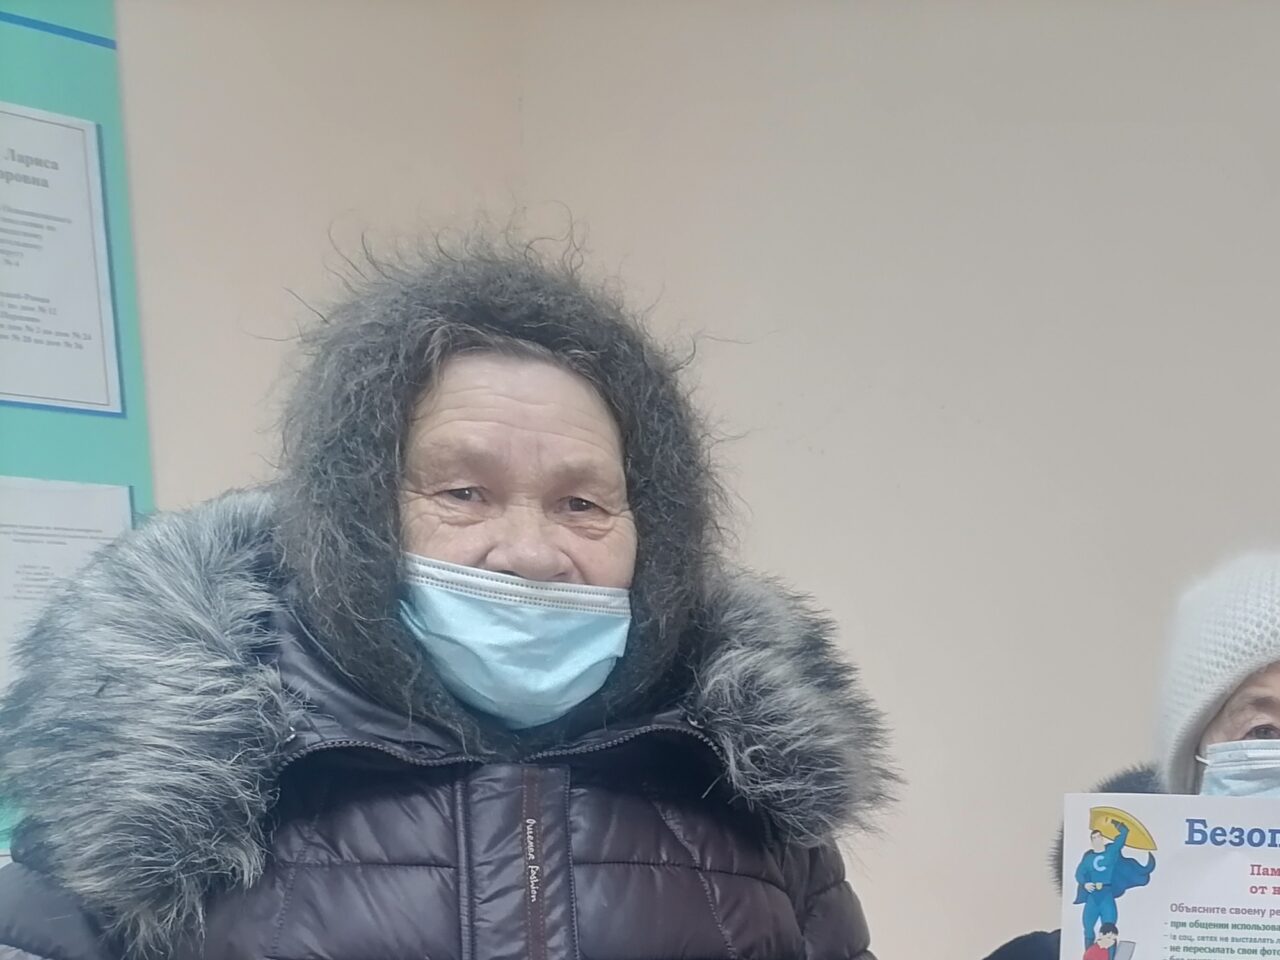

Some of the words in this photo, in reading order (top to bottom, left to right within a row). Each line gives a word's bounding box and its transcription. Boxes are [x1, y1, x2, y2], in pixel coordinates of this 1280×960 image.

[1249, 884, 1266, 895] от
[1169, 903, 1226, 915] Объясните
[1228, 907, 1265, 918] своему
[1169, 920, 1186, 931] при
[1188, 918, 1229, 930] общении
[1169, 945, 1180, 953] не
[1182, 945, 1235, 956] пересылать
[1236, 947, 1257, 955] свои
